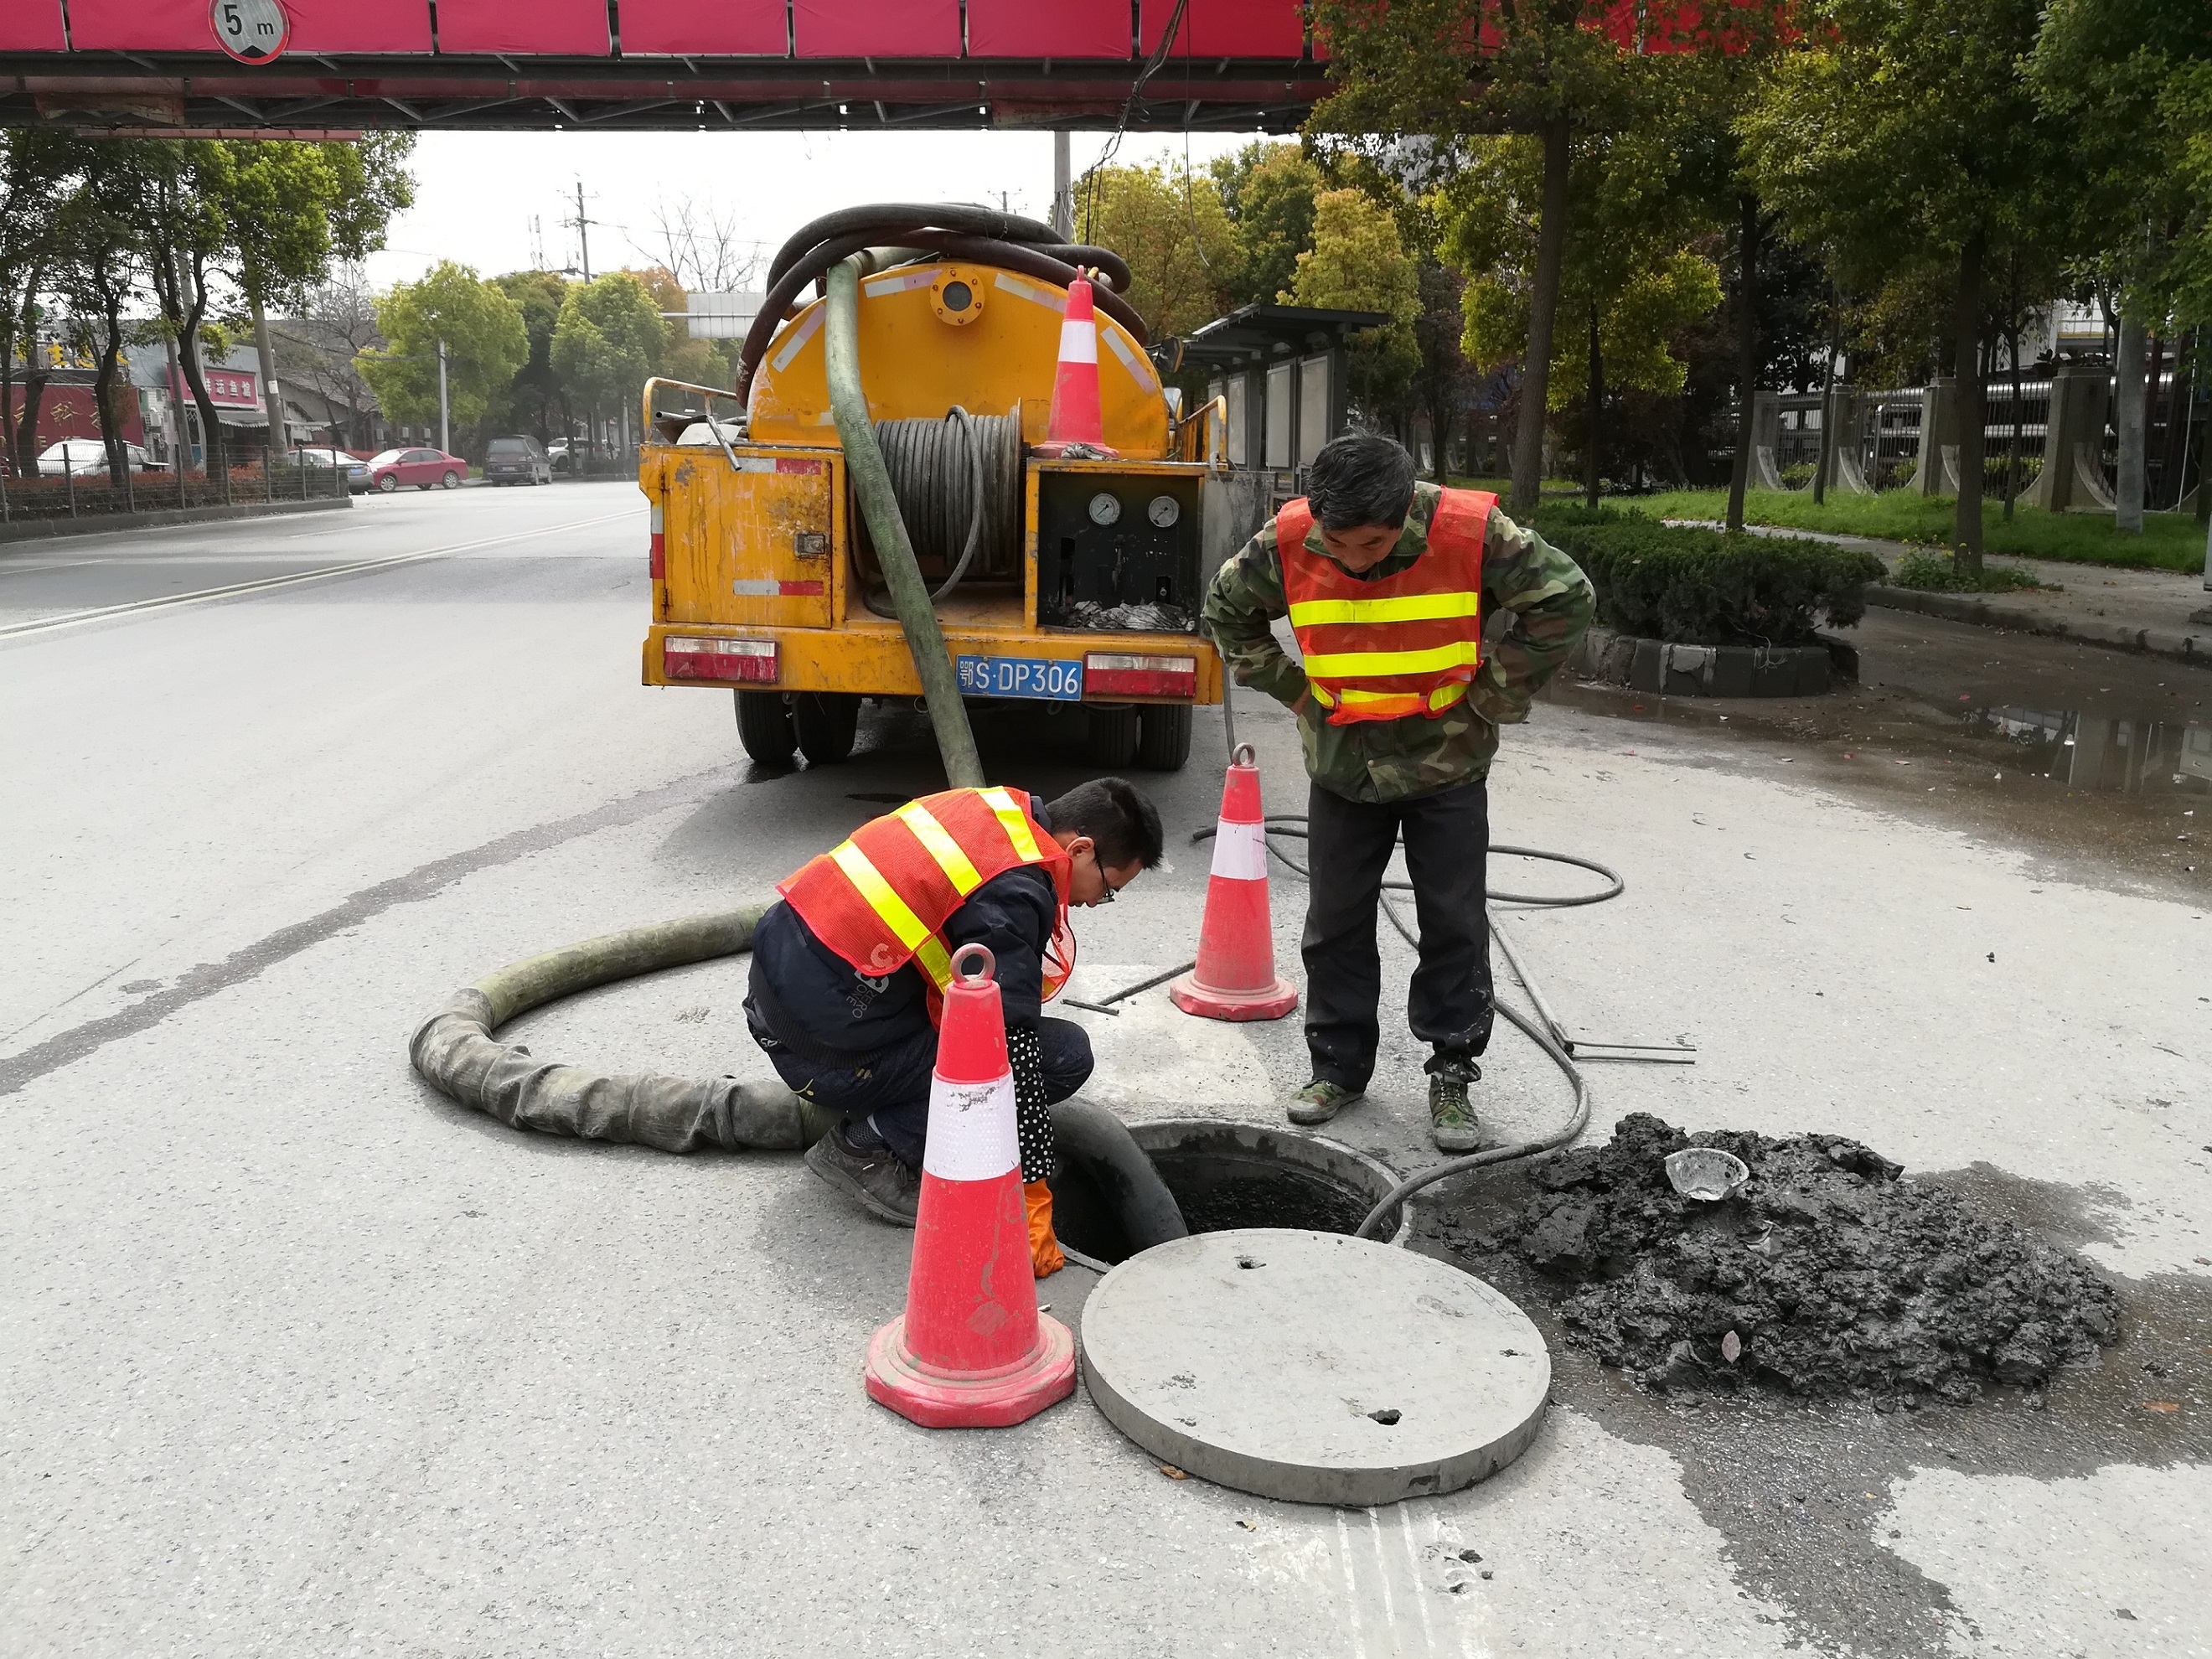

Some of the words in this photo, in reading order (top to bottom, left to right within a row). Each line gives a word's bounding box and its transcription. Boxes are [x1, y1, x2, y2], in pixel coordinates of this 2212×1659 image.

[224, 4, 242, 35] 5
[256, 22, 274, 35] m
[845, 984, 867, 1005] ONE
[852, 990, 877, 1019] ZERO
